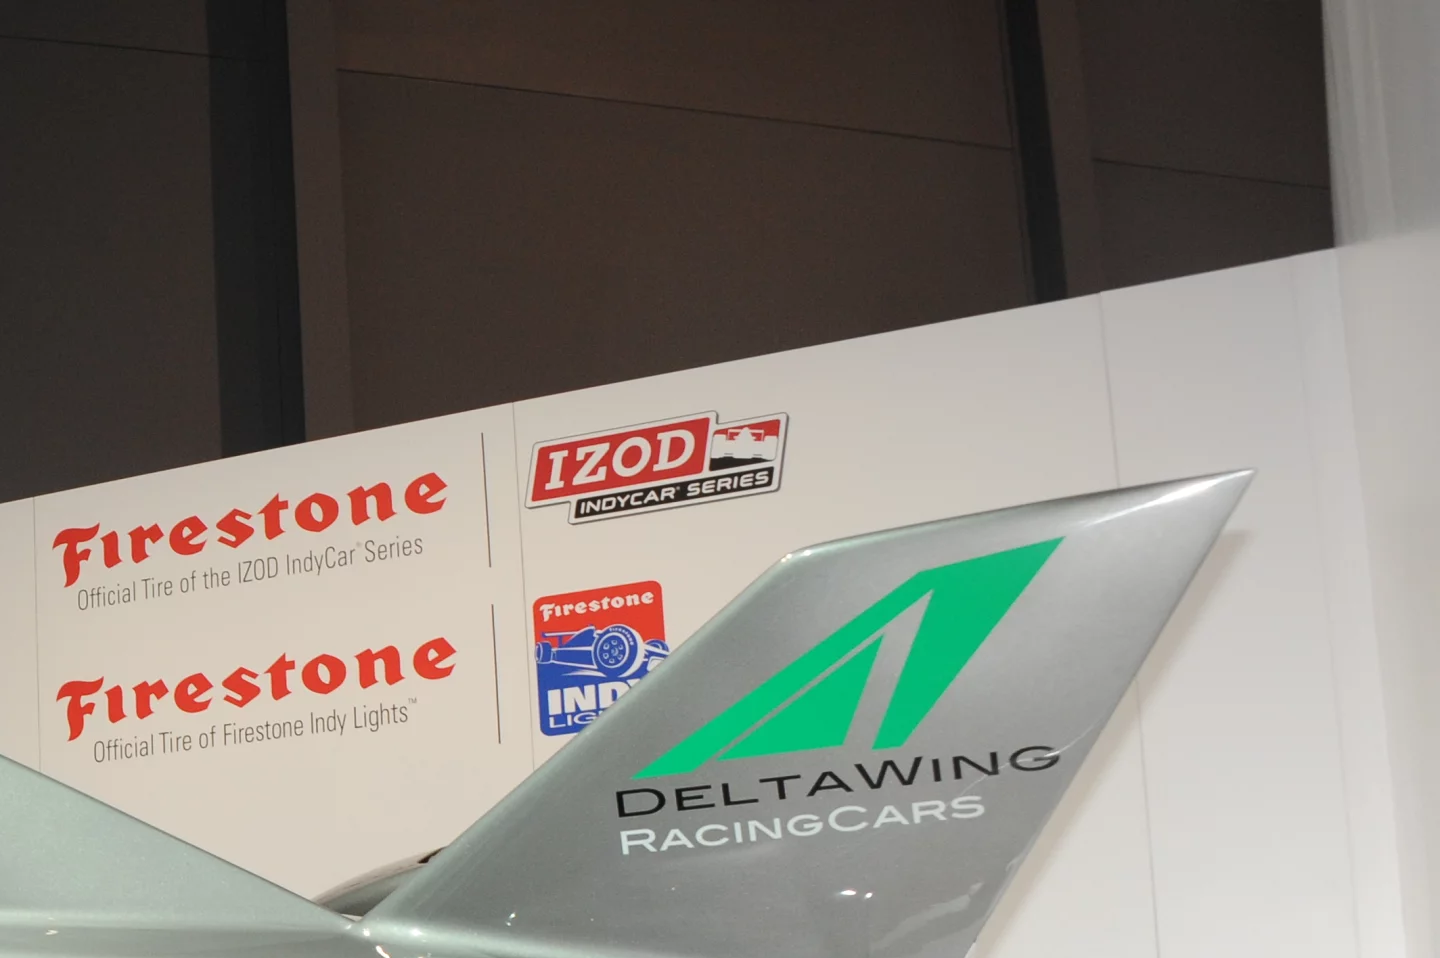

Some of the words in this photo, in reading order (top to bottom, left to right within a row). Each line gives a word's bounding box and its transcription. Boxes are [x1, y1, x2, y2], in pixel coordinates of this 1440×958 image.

[544, 428, 696, 491] IZOD
[686, 471, 769, 497] SERIES
[52, 472, 448, 588] Firestone
[77, 581, 136, 611] Official
[141, 576, 173, 600] Tire
[180, 571, 197, 594] of
[203, 567, 231, 590] the
[238, 556, 279, 584] IZOD
[364, 536, 424, 563] Series
[539, 591, 654, 622] Firestone
[56, 636, 457, 742] Firestone
[549, 711, 604, 728] LIG
[93, 733, 154, 763] Official
[159, 730, 192, 755] Tire
[198, 725, 216, 750] of
[223, 715, 304, 747] Firestone
[310, 710, 347, 737] Indy
[615, 745, 1060, 818] DELTAWING
[619, 795, 986, 855] RACINGCARS
